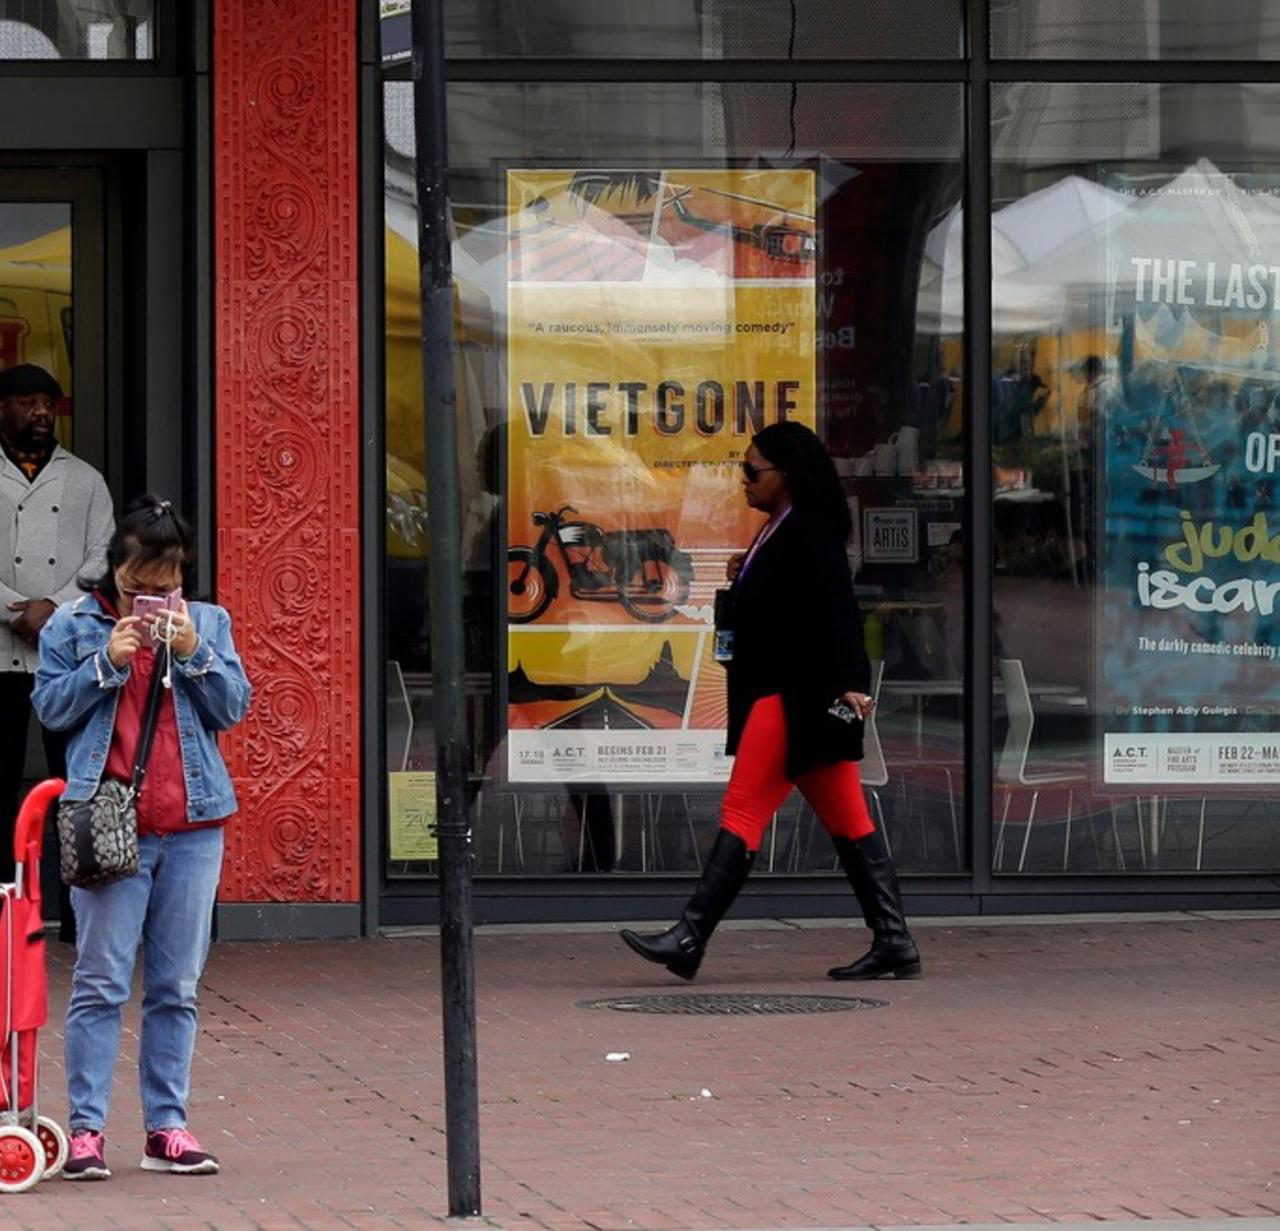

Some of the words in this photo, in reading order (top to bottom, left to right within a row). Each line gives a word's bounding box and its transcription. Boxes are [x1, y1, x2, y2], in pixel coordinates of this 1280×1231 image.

[1131, 257, 1196, 305] THE
[548, 323, 605, 335] raucous,
[681, 323, 732, 335] moving
[521, 379, 800, 437] VIETGONE
[1138, 636, 1157, 651] The
[1158, 638, 1189, 655] darkly
[1191, 640, 1232, 655] comedic
[1233, 642, 1276, 660] celebrity
[1131, 705, 1173, 717] Stephen
[1176, 705, 1199, 717] Adly
[1201, 705, 1238, 717] Guirgis
[552, 747, 587, 758] A.C.T.
[597, 745, 633, 756] BEGINS
[635, 745, 654, 756] FEB
[655, 745, 666, 756] 21
[1112, 747, 1148, 758] A.C.T.
[1218, 746, 1237, 759] FEB
